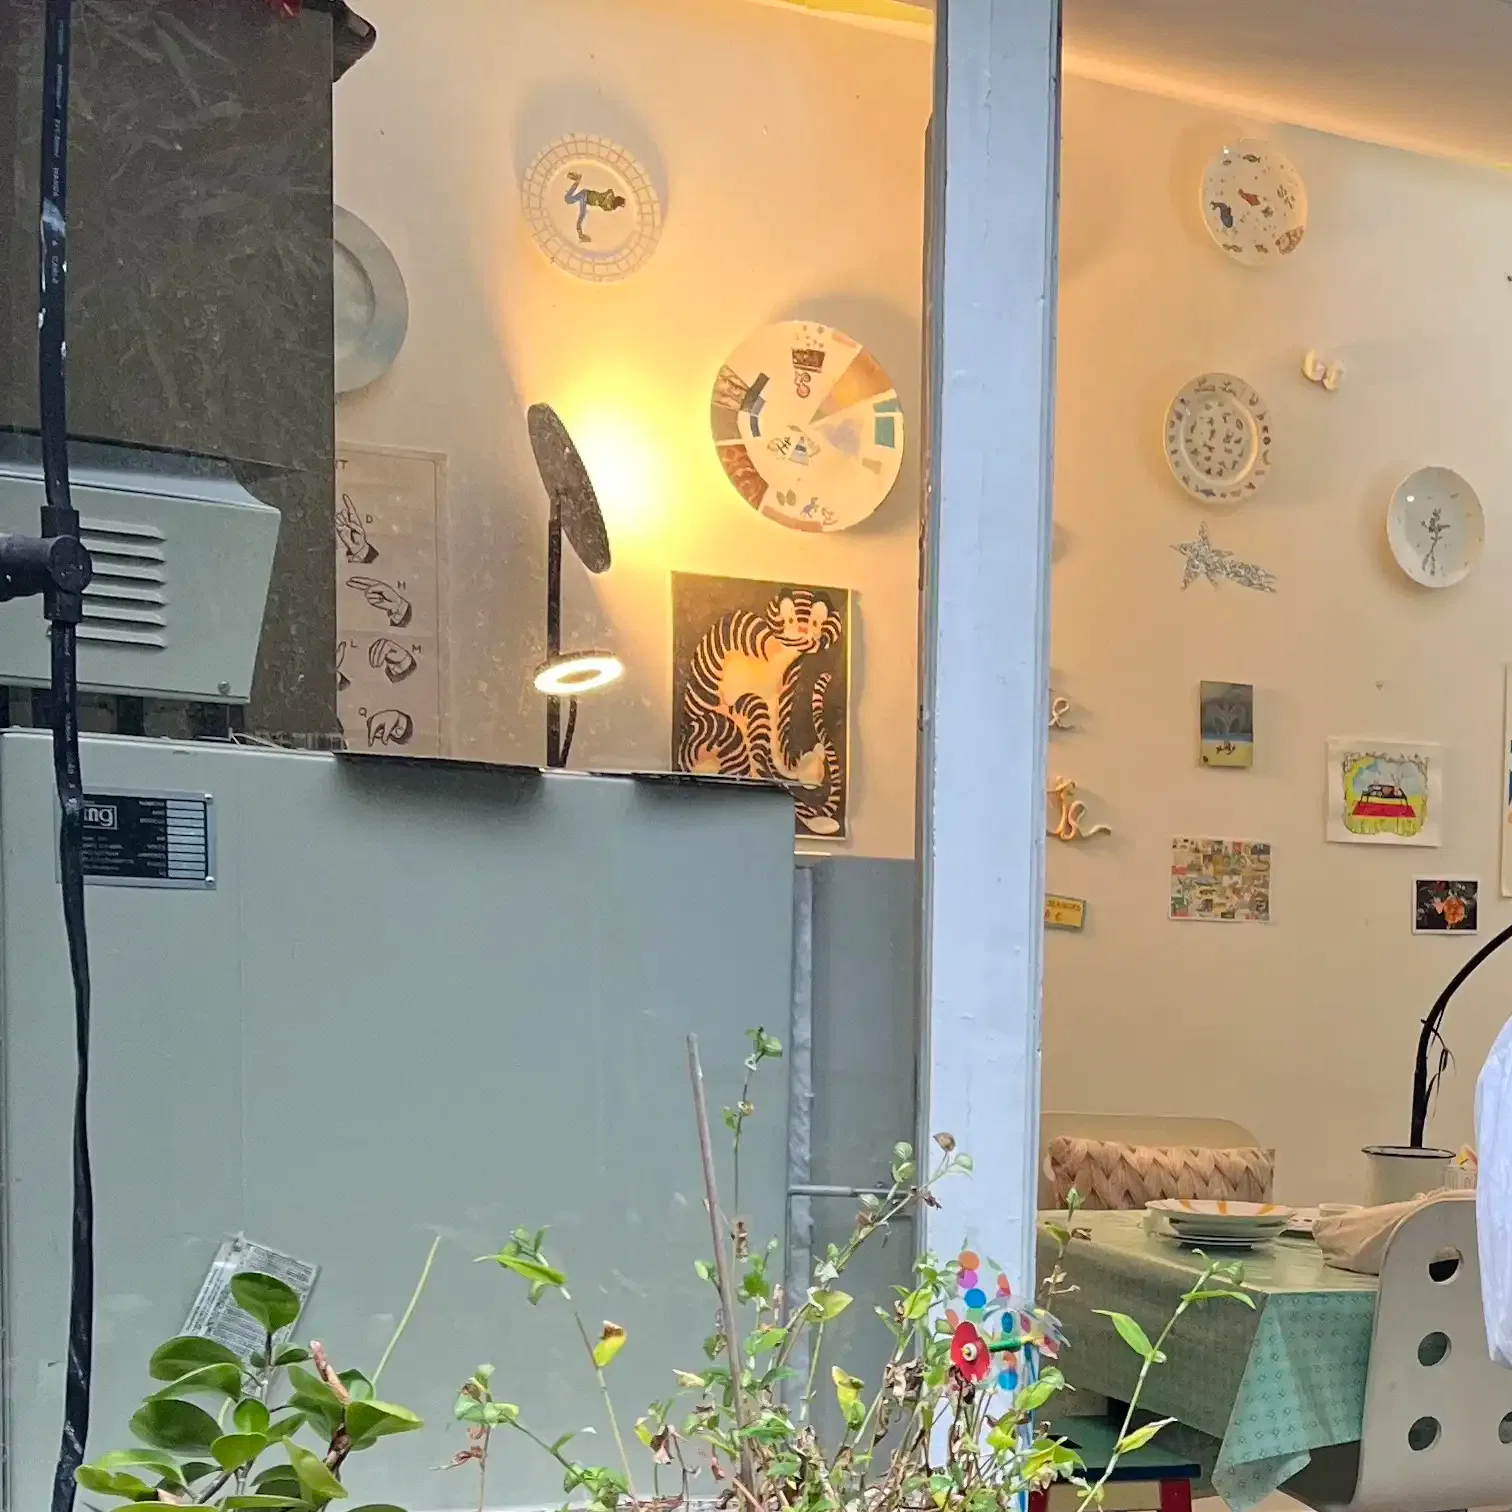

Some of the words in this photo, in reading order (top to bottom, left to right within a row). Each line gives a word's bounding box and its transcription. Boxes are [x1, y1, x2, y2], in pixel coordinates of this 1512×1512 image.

[365, 514, 374, 524] D
[397, 580, 407, 590] H
[350, 639, 359, 649] L
[411, 644, 423, 654] M
[358, 706, 368, 718] Q
